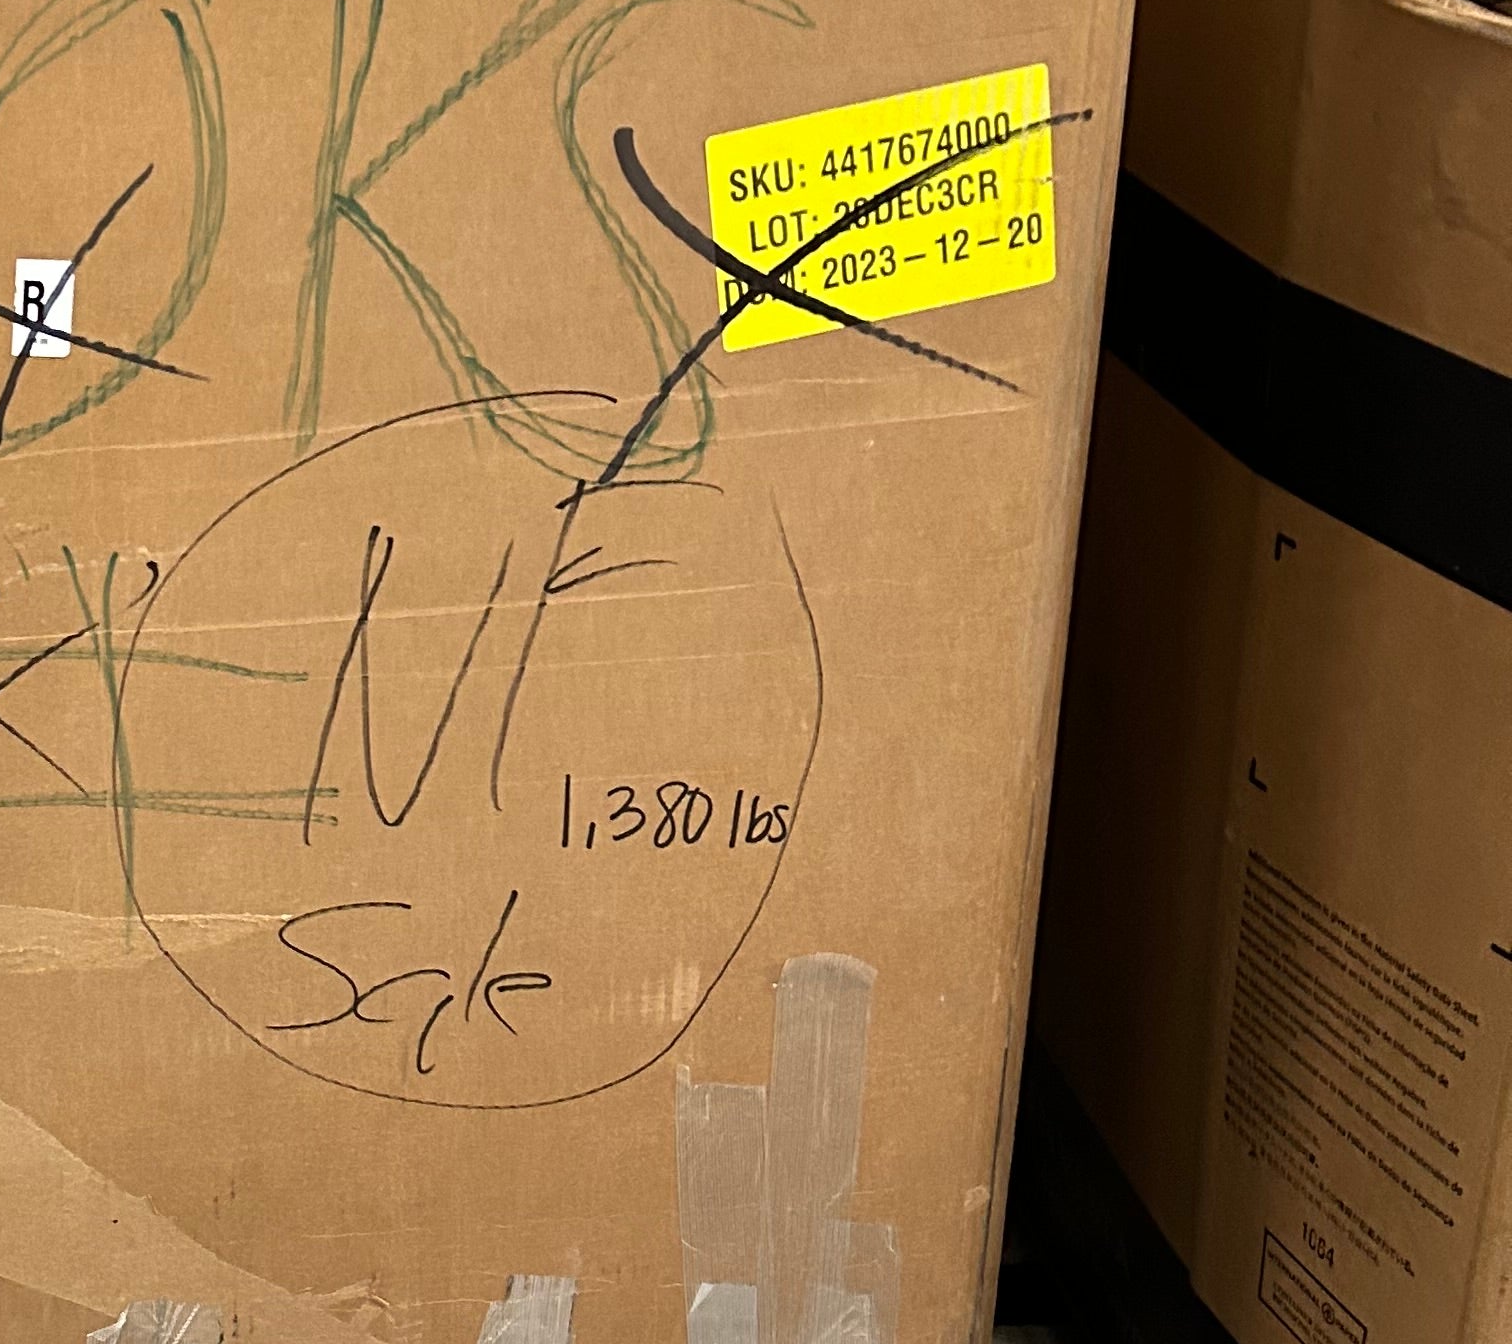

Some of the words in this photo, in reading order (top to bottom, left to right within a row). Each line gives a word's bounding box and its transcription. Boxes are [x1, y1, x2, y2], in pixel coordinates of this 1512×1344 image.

[729, 157, 807, 203] SKU:
[821, 112, 1011, 181] 4417674000
[749, 210, 819, 253] LOT:
[304, 479, 725, 846] NF
[561, 774, 713, 849] 1,380
[730, 787, 788, 849] lbs
[266, 890, 553, 1074] Sale
